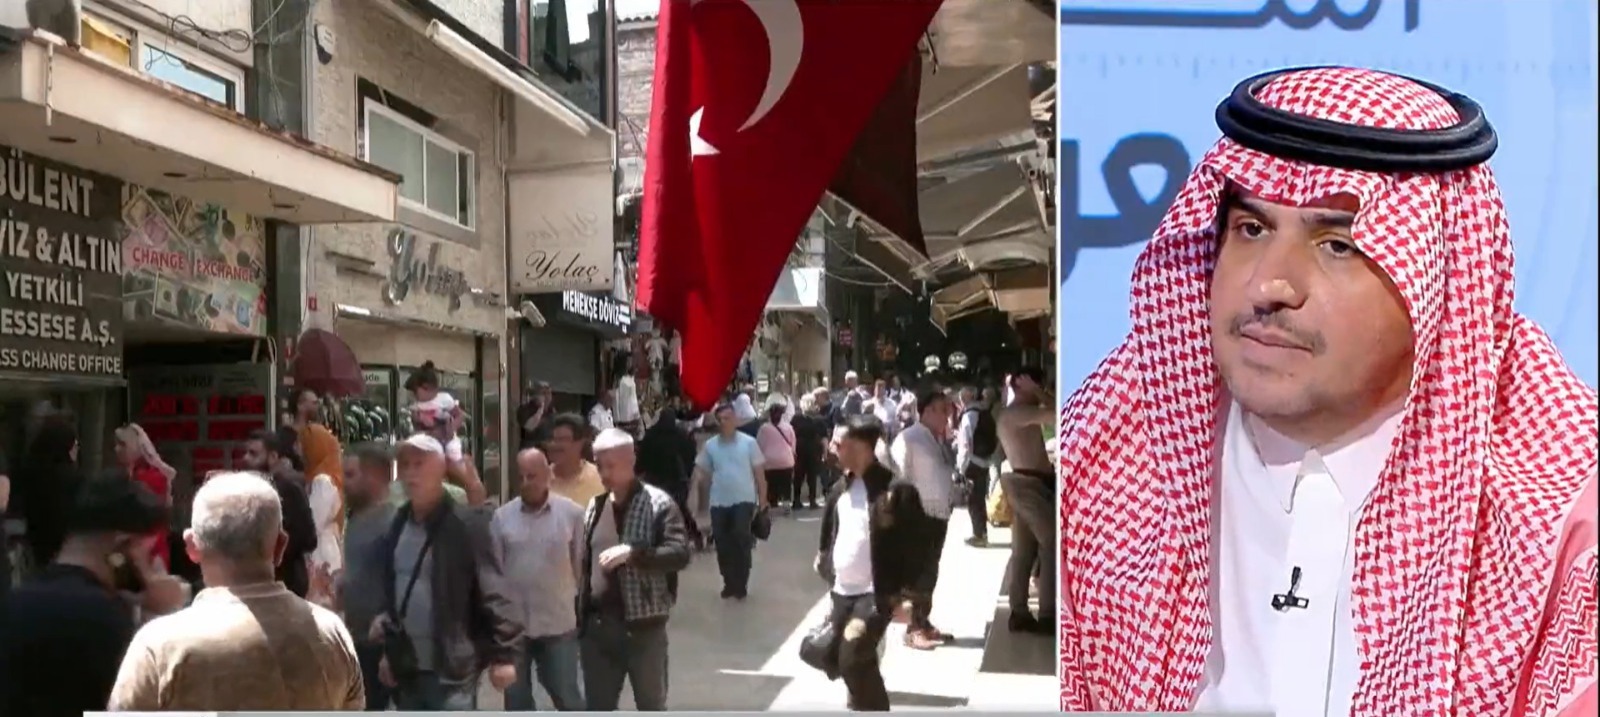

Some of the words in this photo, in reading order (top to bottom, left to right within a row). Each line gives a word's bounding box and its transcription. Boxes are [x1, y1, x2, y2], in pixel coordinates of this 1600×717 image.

[36, 227, 53, 263] &
[58, 231, 121, 276] ALTIN
[132, 247, 185, 270] CHANGE
[196, 259, 255, 282] EXCHANGE
[525, 250, 599, 283] Yolaç
[6, 271, 83, 307] YETKİLİ
[563, 290, 598, 321] MENEKŞE
[599, 296, 620, 326] DÖVİZ
[1, 308, 76, 340] ESSESE
[80, 318, 116, 348] A.Ş.
[0, 349, 19, 367] SS
[22, 350, 76, 371] CHANGE
[79, 354, 121, 374] OFFICE
